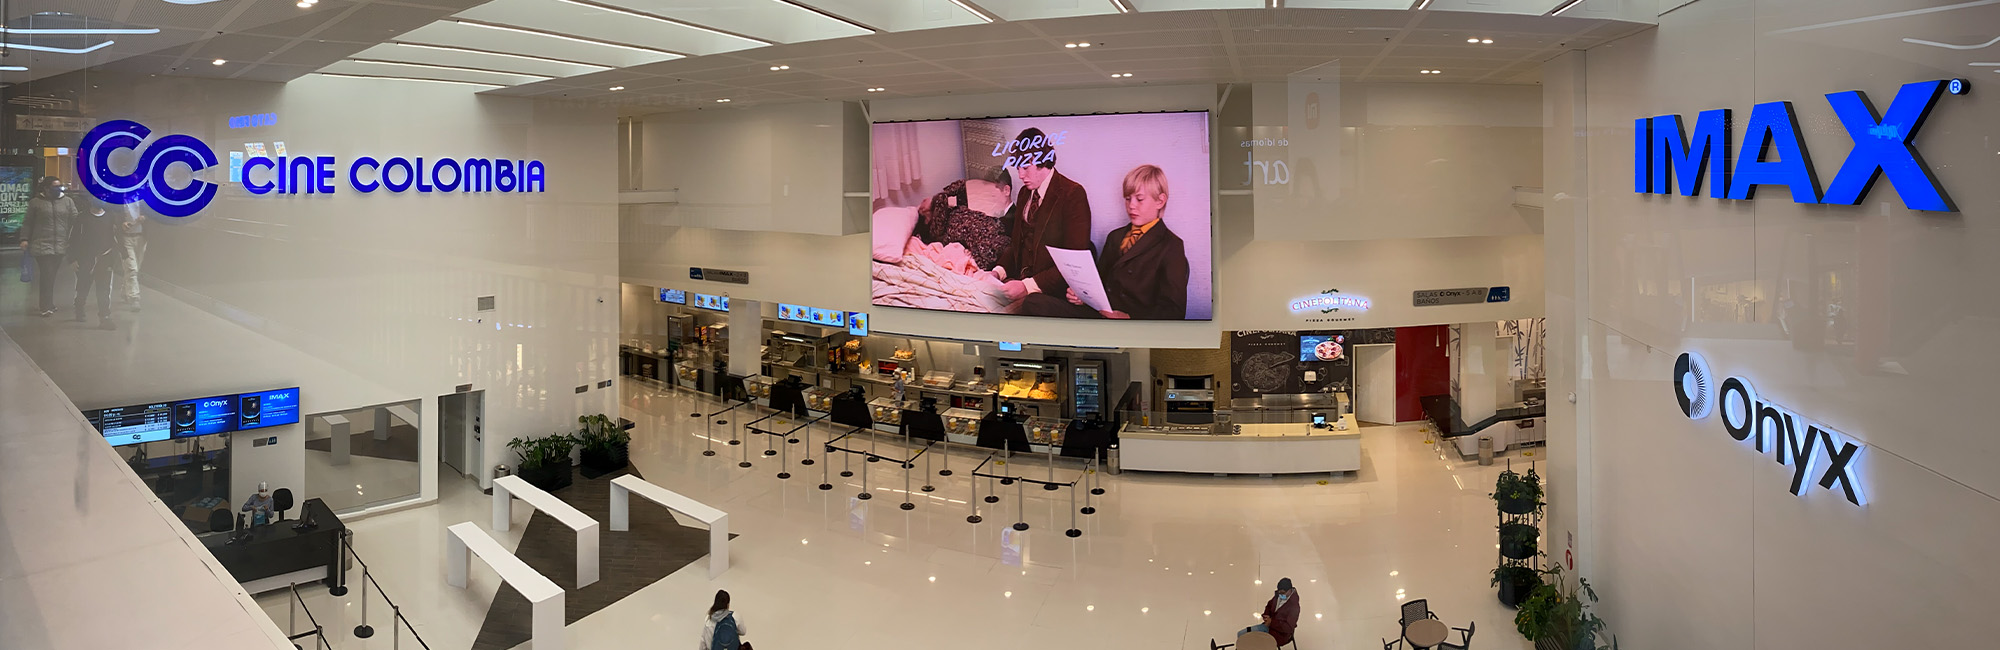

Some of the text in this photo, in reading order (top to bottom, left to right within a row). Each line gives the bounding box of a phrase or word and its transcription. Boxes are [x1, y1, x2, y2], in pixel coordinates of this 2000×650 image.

[992, 131, 1068, 157] LICORICE
[1635, 80, 1958, 212] IMAX
[1002, 149, 1056, 171] PIZZA
[242, 156, 546, 195] CINE COLOMBIA
[1292, 297, 1369, 311] CINEPOLITANA
[210, 400, 228, 408] Onyx
[1719, 376, 1868, 507] Onyx
